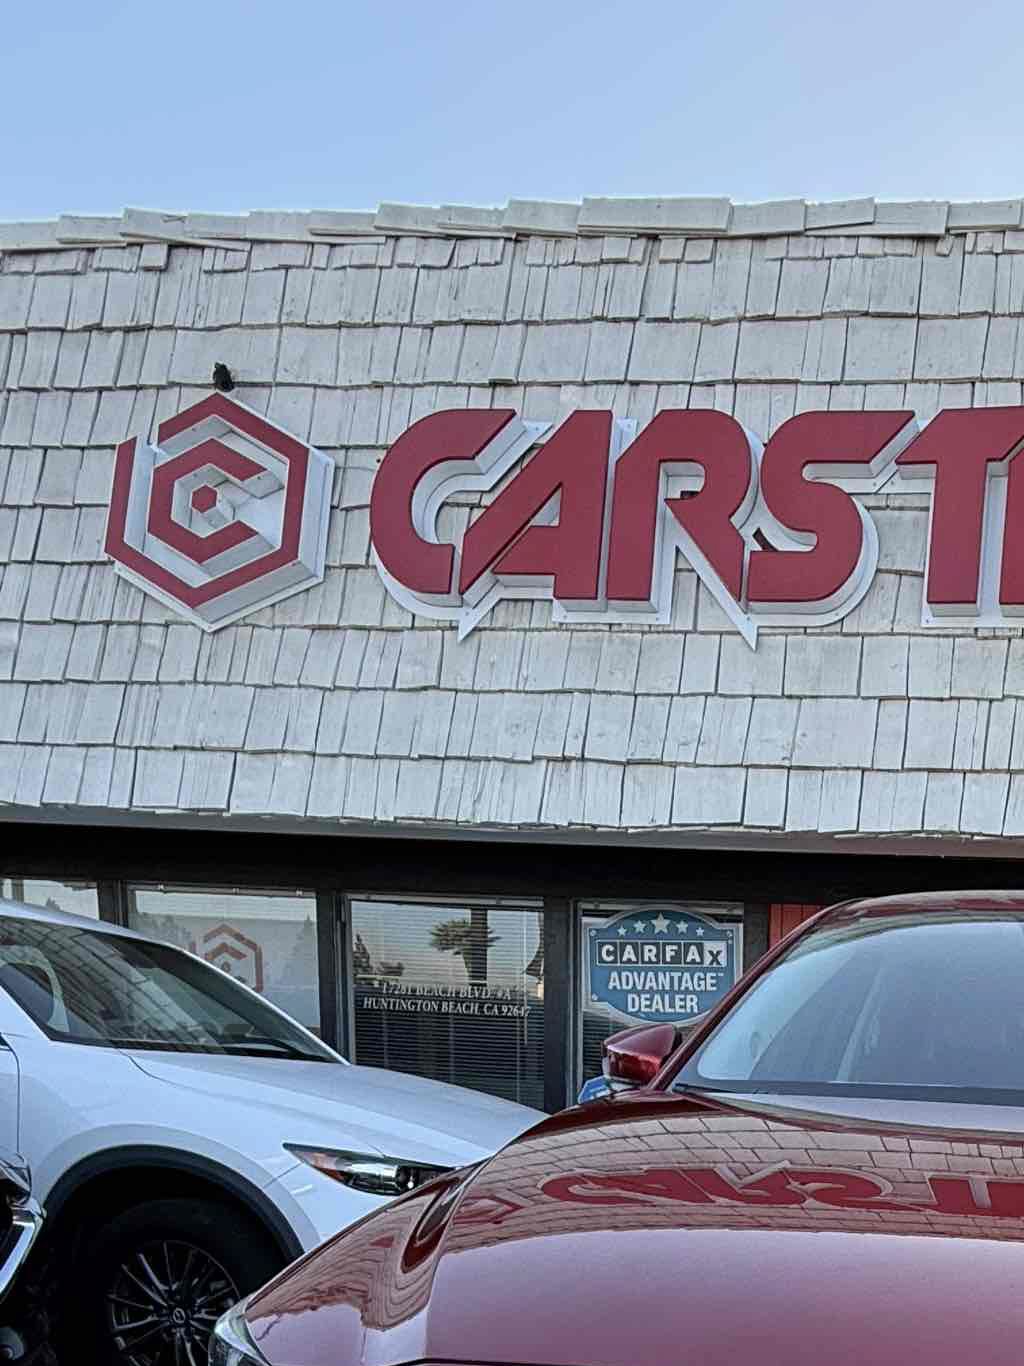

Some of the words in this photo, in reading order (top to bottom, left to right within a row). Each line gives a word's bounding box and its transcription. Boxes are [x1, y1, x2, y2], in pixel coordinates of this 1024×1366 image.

[600, 944, 723, 966] CARFAX
[415, 984, 458, 997] BEACH
[608, 971, 718, 991] ADVANTAGE
[363, 997, 440, 1012] HUNTINGTON
[483, 1003, 499, 1016] CA
[627, 994, 699, 1013] DEALER
